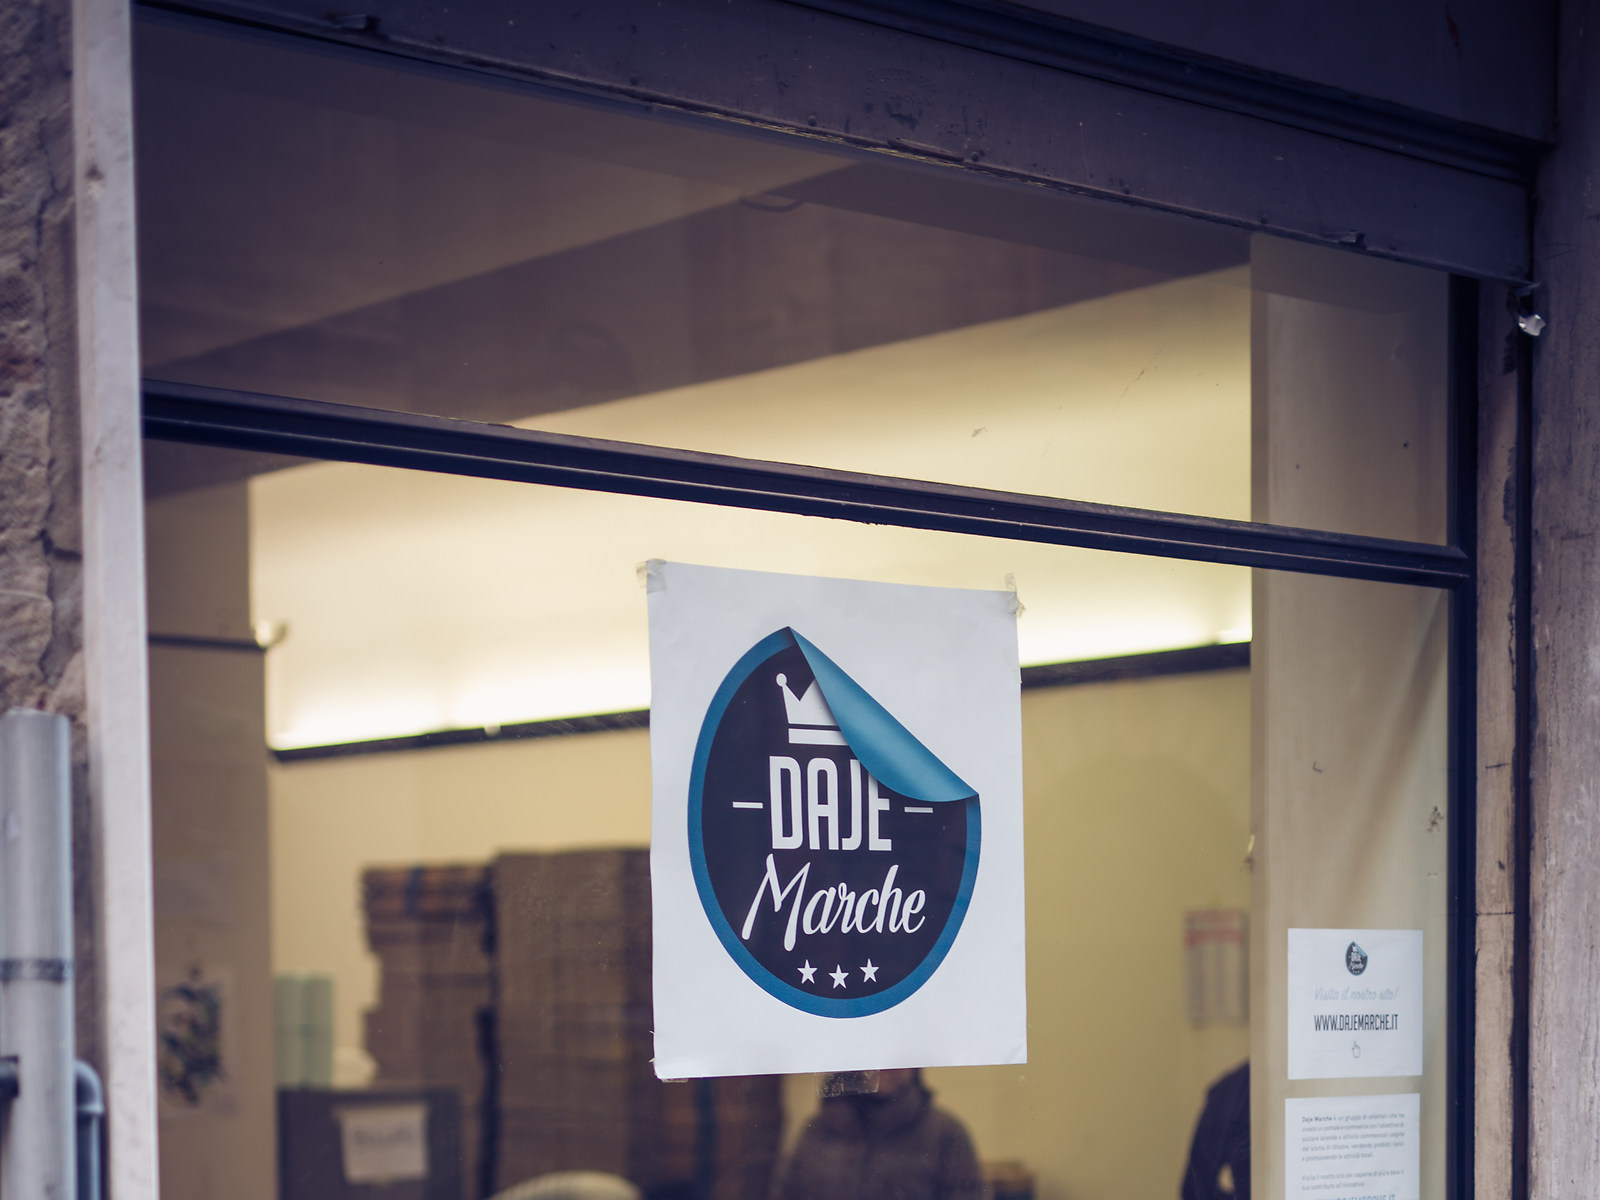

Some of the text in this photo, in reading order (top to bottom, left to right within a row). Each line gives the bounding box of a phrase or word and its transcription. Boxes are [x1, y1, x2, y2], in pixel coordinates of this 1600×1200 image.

[769, 756, 892, 851] DAJE
[742, 853, 926, 951] Marche
[1314, 1014, 1398, 1031] WWW.DAJEMARCHE.IT
